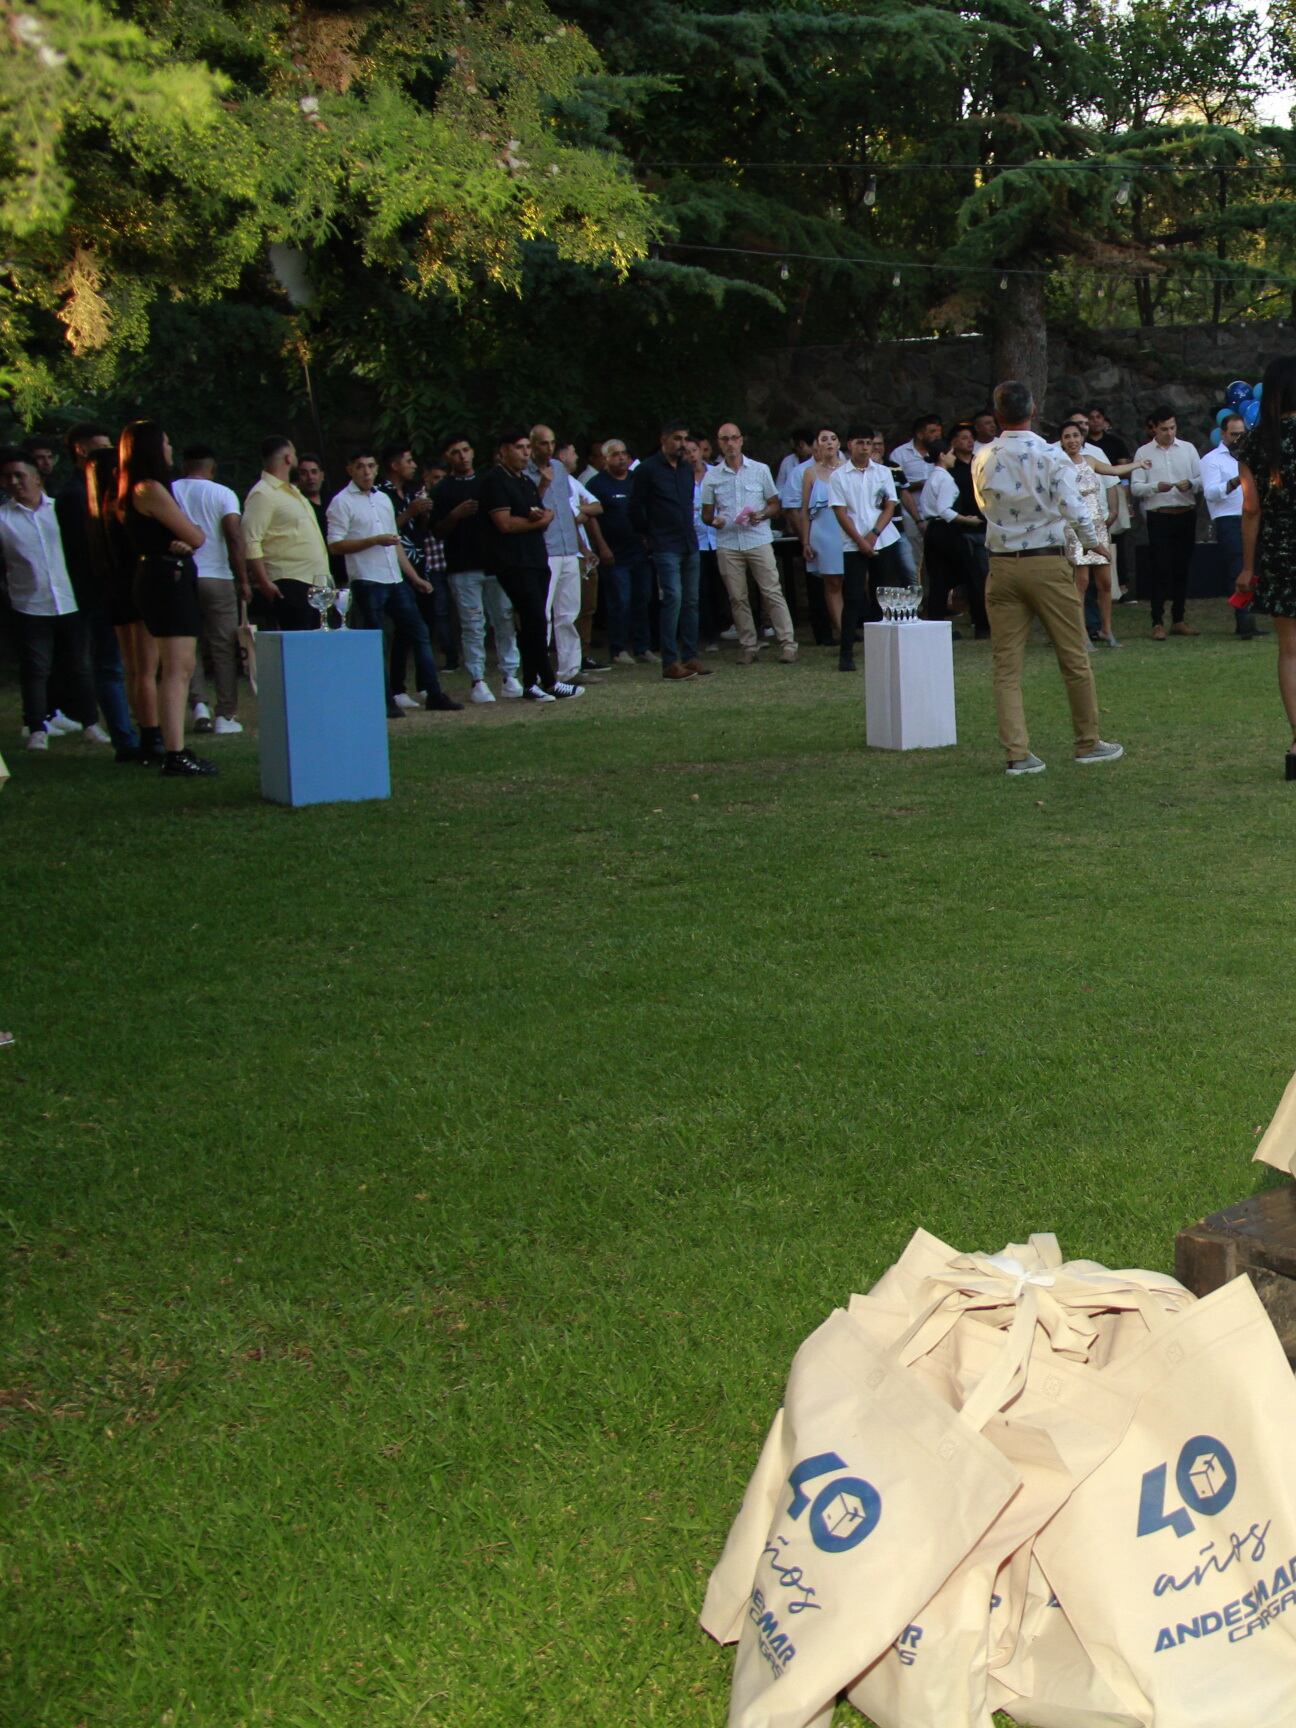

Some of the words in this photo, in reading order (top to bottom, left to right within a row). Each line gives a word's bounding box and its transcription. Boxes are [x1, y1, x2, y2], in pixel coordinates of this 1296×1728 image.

[786, 1451, 882, 1554] 40
[1136, 1434, 1238, 1539] 40
[764, 1535, 822, 1614] ños
[1153, 1519, 1272, 1597] años
